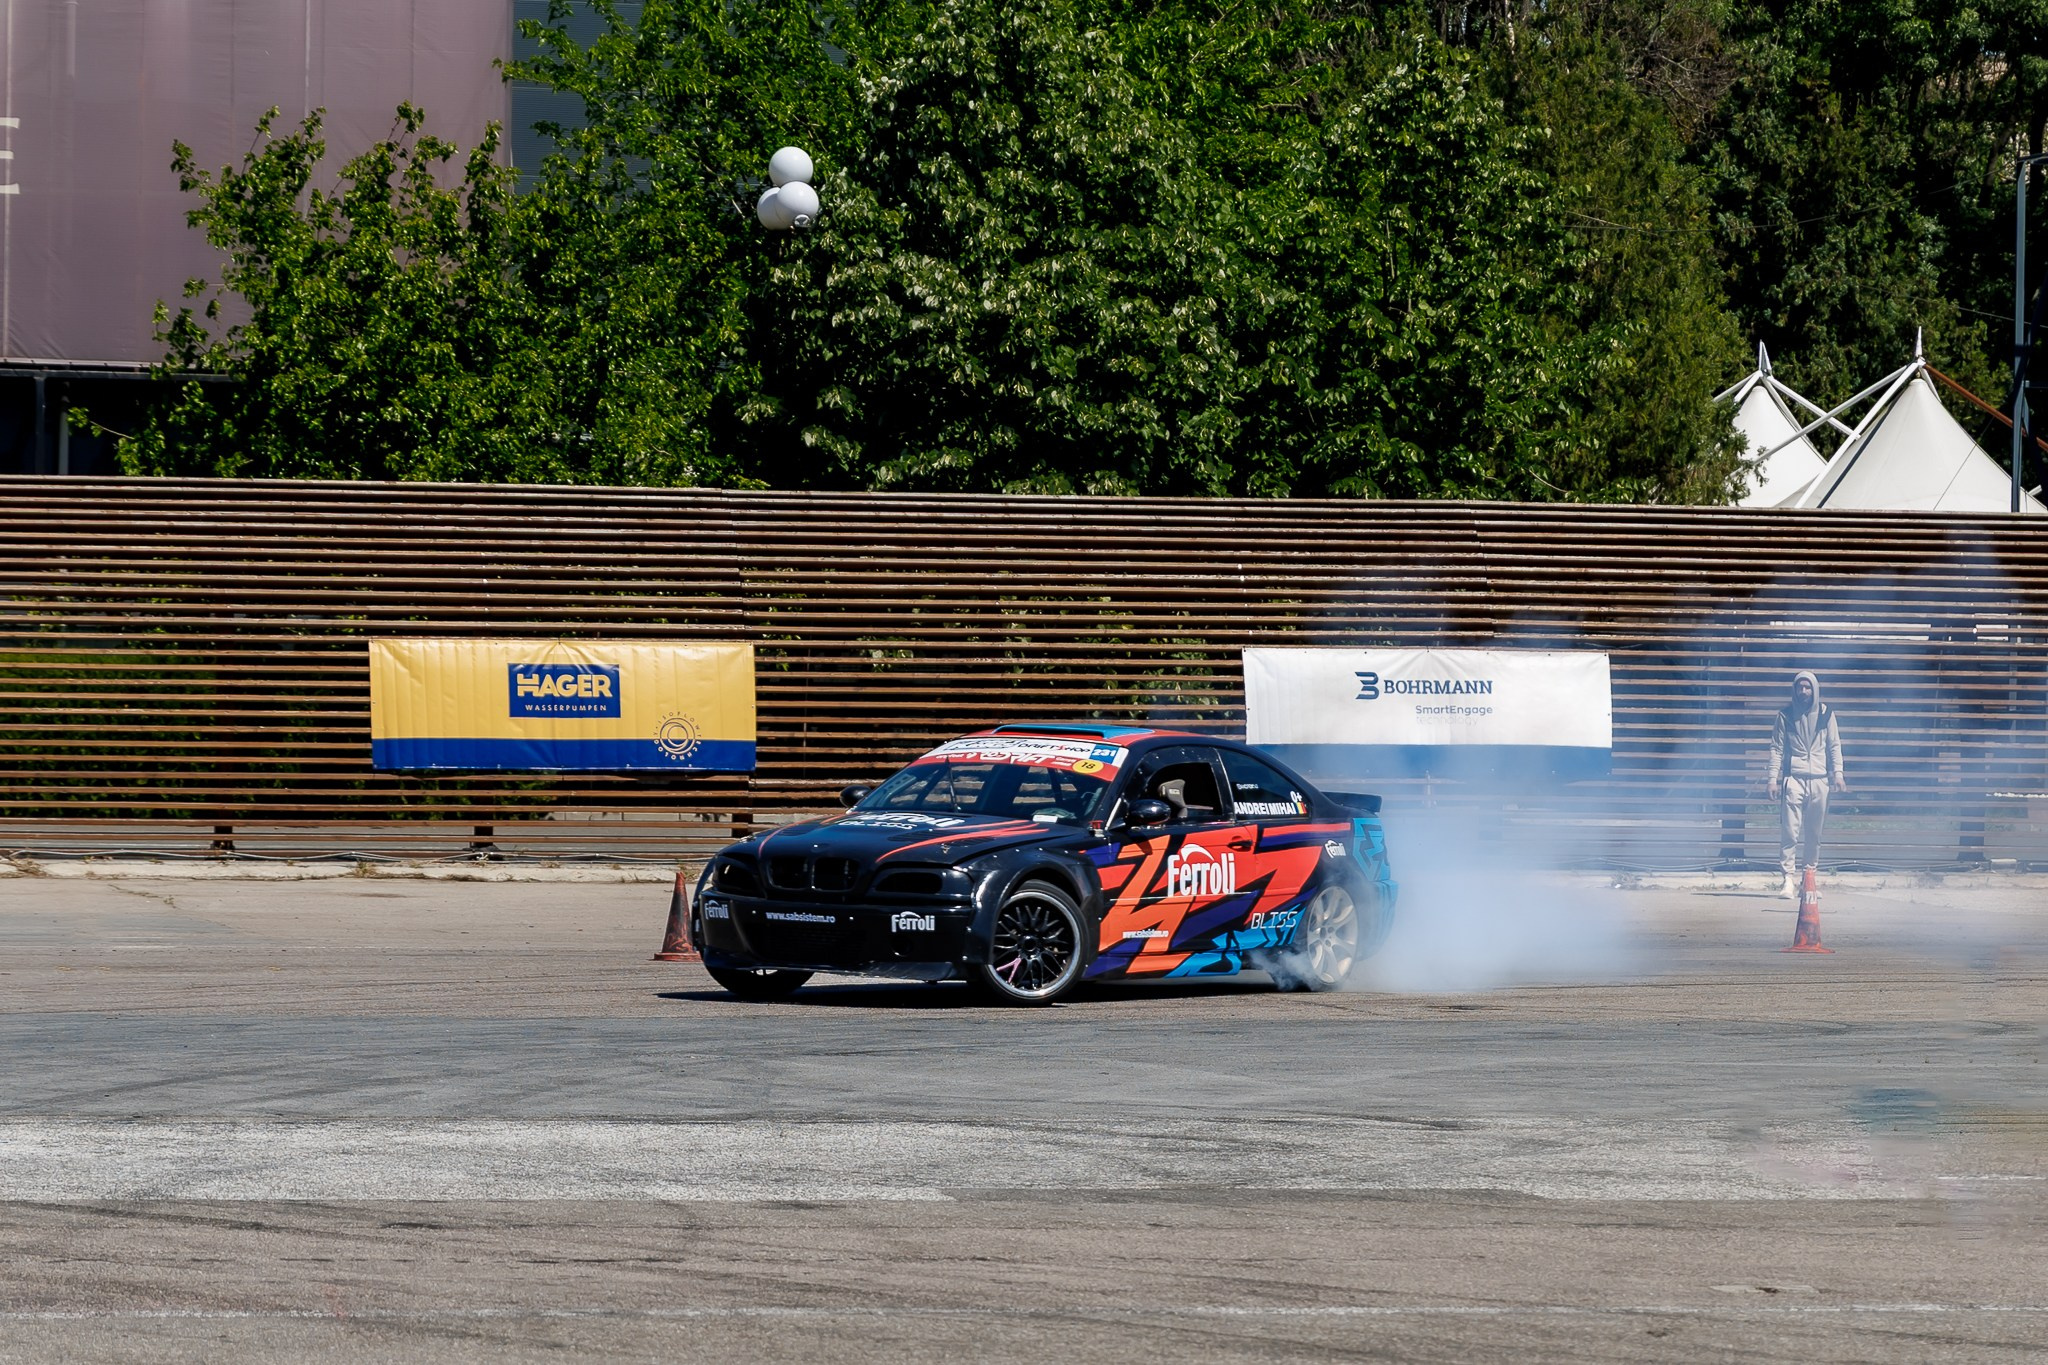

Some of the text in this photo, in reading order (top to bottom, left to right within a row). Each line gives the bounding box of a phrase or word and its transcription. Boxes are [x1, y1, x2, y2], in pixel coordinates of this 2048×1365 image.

[516, 673, 613, 698] HAGER
[1383, 679, 1493, 694] BOHRMANN
[525, 704, 607, 712] WASSERPUMPEN
[1415, 705, 1493, 716] SmartEngage
[1167, 850, 1236, 897] Ferroli
[704, 903, 729, 919] Ferroli
[765, 911, 836, 923] www.sabsistem.ro
[891, 912, 936, 933] Ferroli
[1250, 911, 1298, 930] BLISS
